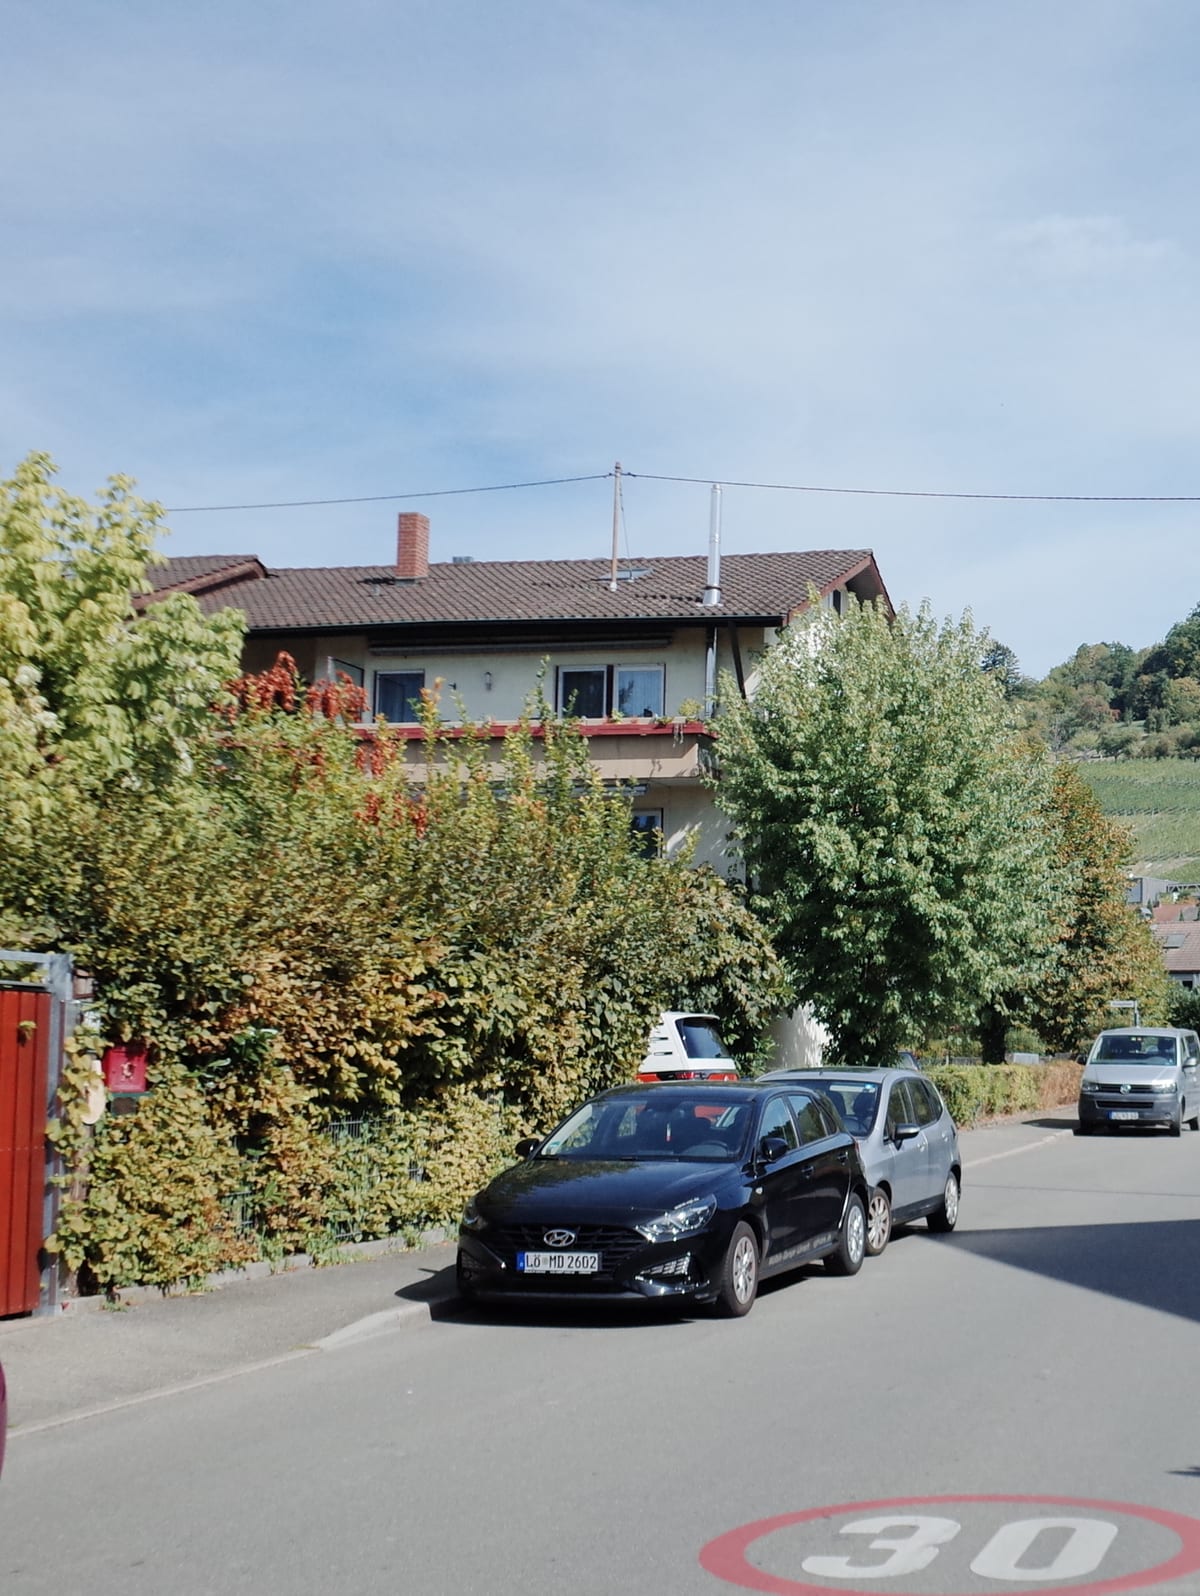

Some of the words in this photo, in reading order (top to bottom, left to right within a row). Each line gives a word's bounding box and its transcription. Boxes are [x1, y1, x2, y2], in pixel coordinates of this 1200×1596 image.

[526, 1254, 541, 1268] LÖ
[549, 1255, 565, 1269] MD
[567, 1255, 598, 1270] 2602
[801, 1515, 1119, 1581] 30
